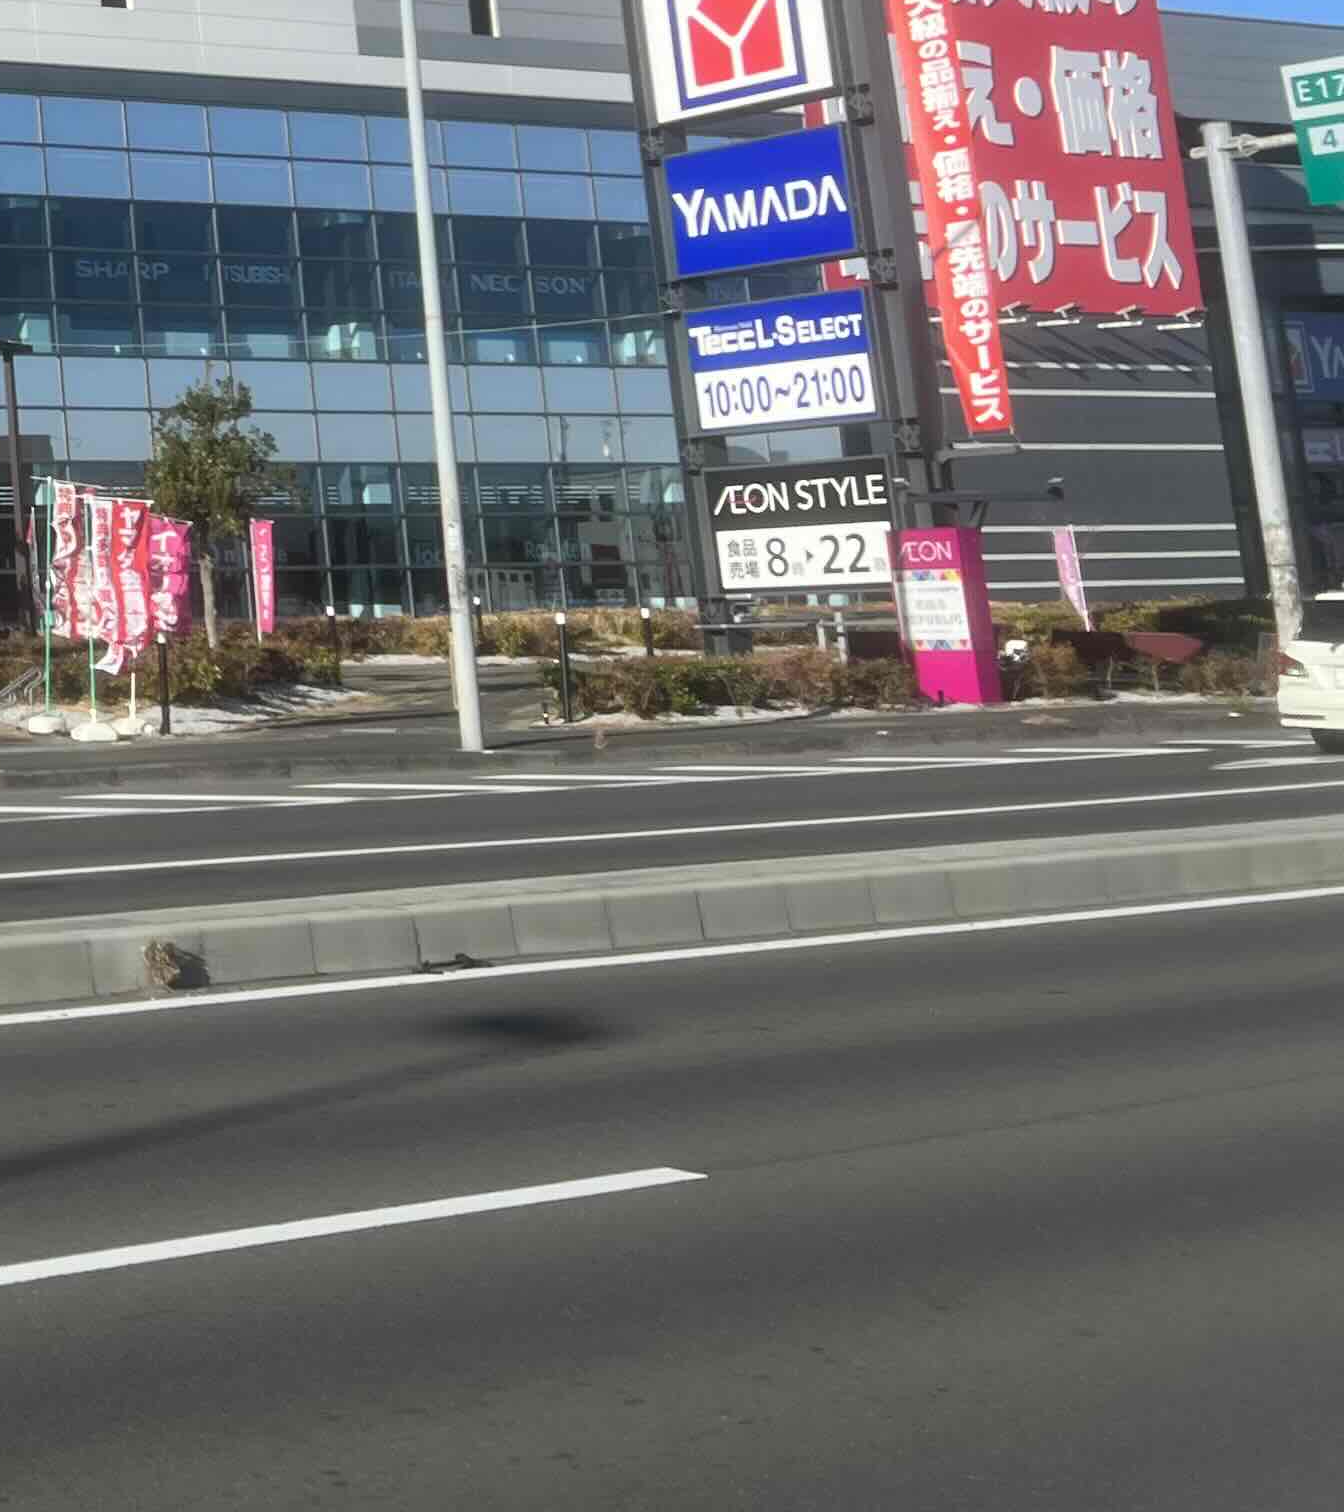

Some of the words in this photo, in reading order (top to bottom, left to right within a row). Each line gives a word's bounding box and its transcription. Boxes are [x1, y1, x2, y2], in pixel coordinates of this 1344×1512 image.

[672, 174, 848, 239] YAMADA
[535, 275, 592, 295] SON
[795, 474, 888, 512] STYLE
[727, 538, 758, 558] 食品
[765, 537, 790, 577] 8
[819, 533, 871, 575] 22
[728, 560, 761, 580] 売場
